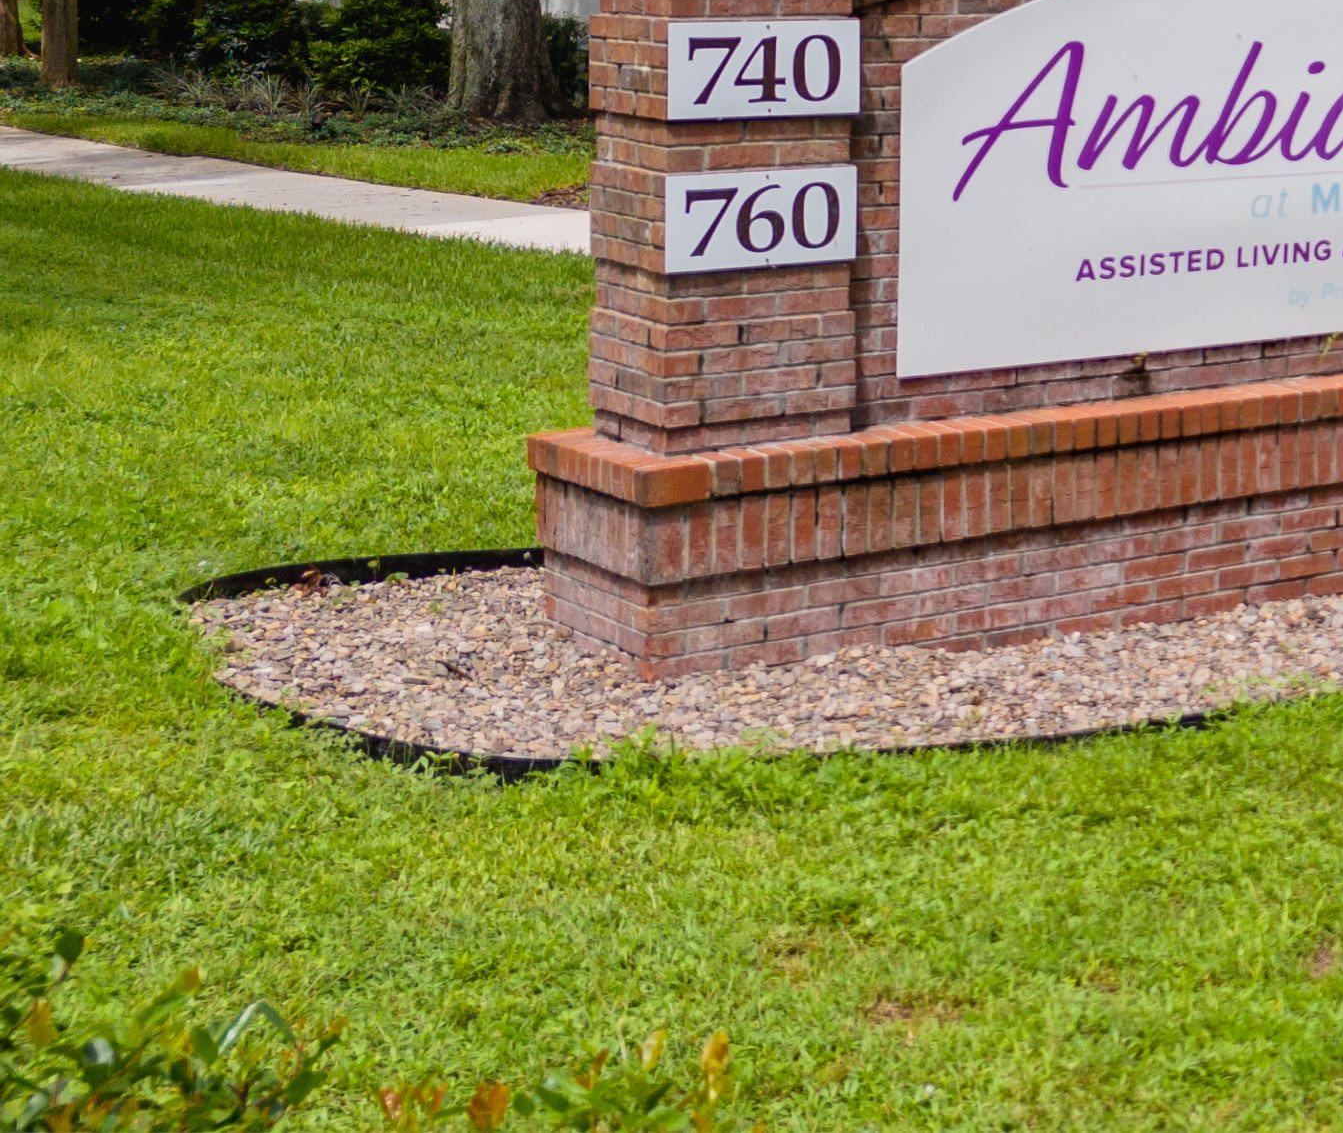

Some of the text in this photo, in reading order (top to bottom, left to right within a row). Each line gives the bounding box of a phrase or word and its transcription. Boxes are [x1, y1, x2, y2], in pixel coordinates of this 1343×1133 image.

[687, 31, 843, 107] 740
[684, 180, 842, 258] 760
[1250, 187, 1290, 219] at
[1075, 247, 1225, 282] ASSISTED
[1236, 239, 1332, 268] LIVING
[1287, 287, 1313, 307] by
